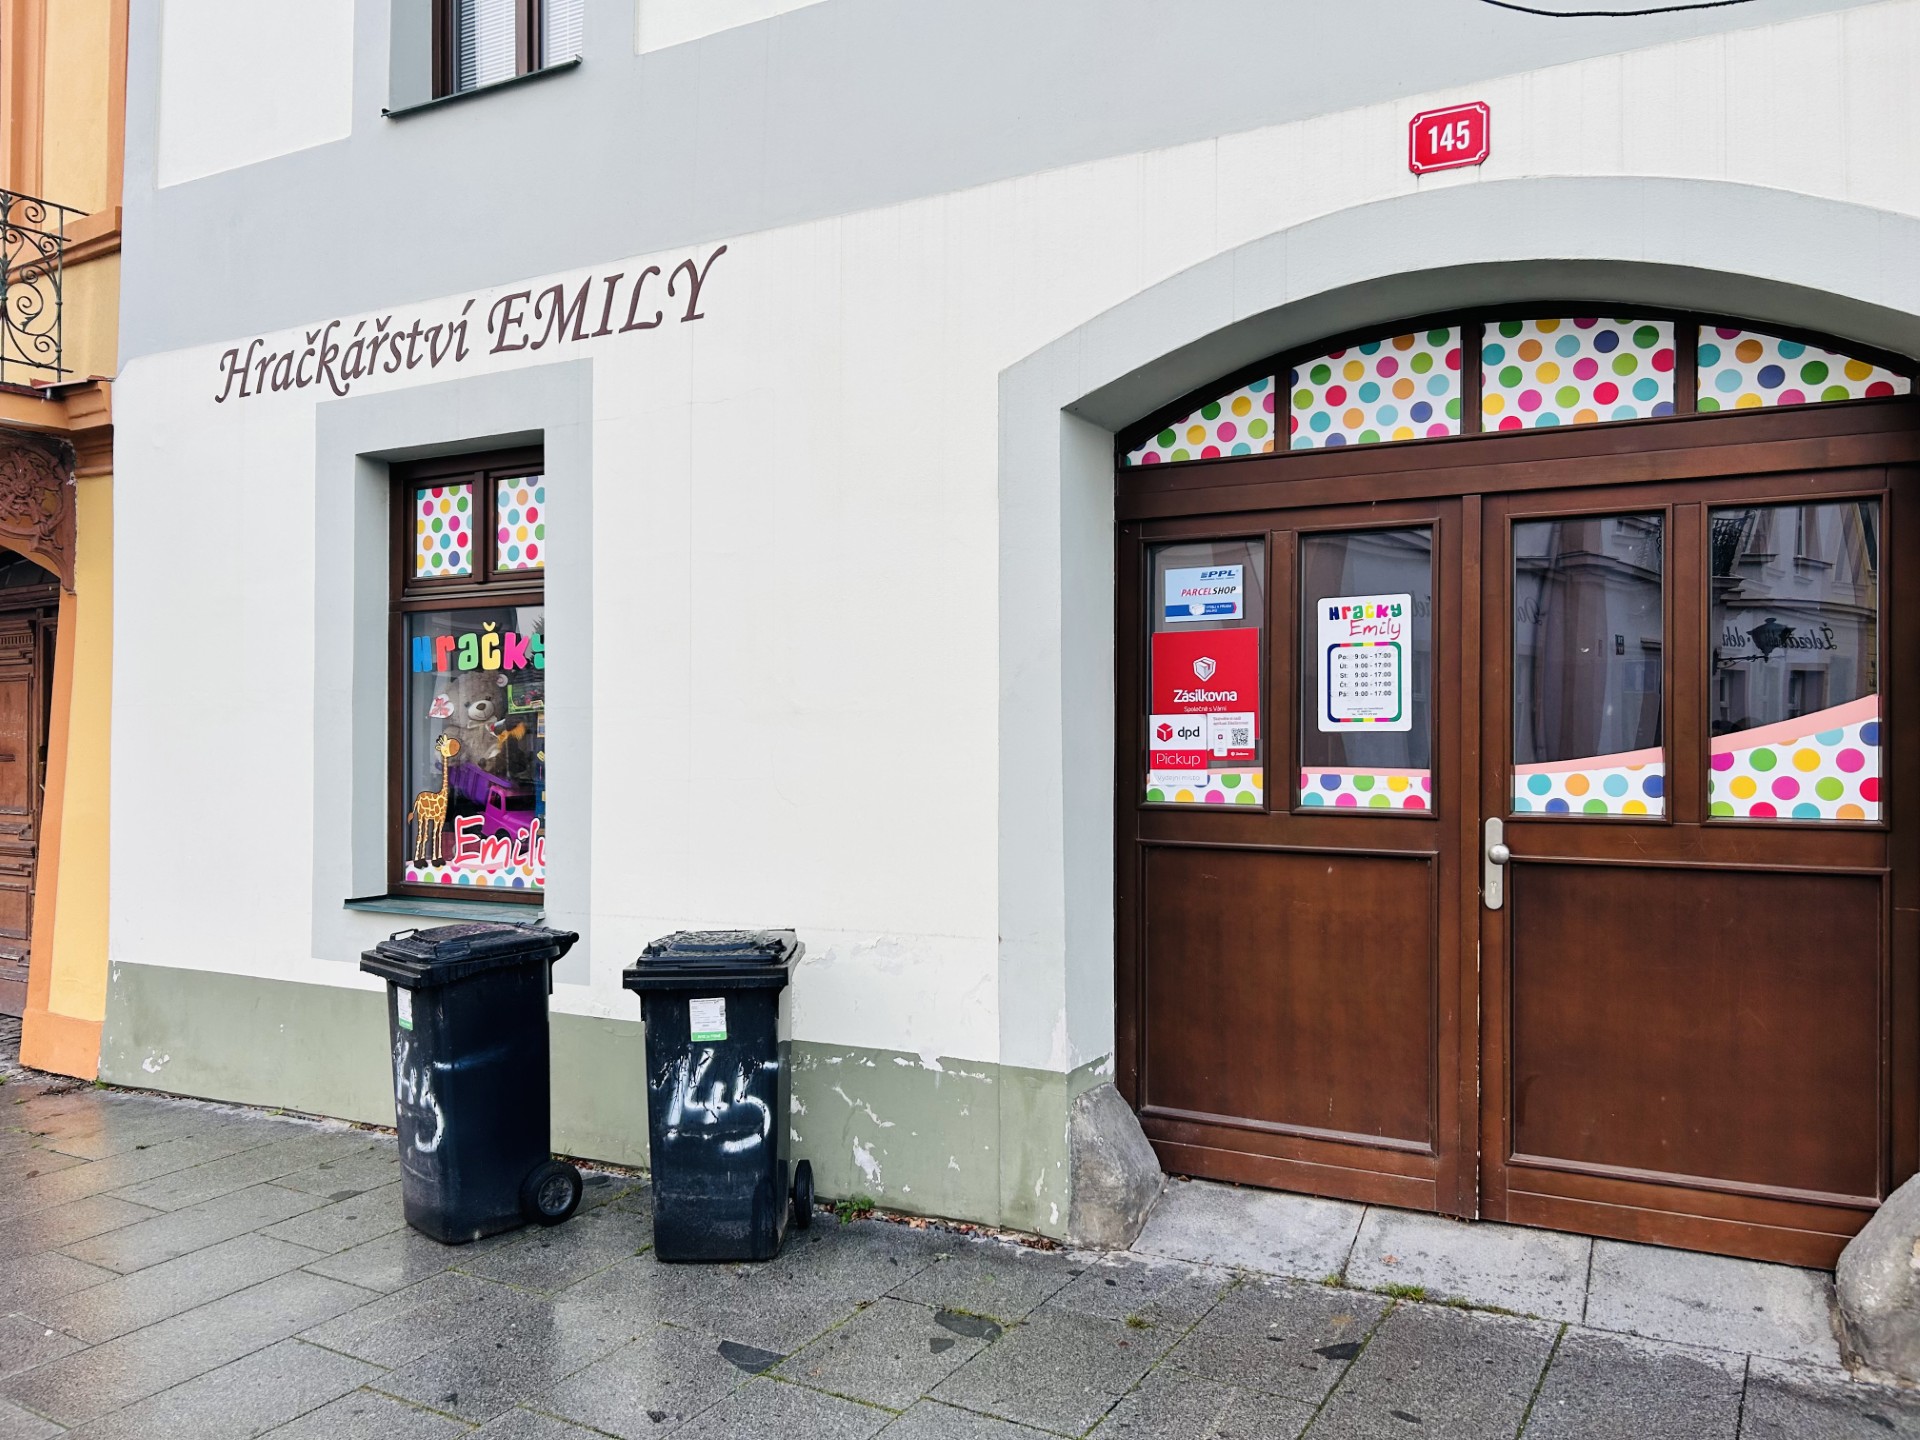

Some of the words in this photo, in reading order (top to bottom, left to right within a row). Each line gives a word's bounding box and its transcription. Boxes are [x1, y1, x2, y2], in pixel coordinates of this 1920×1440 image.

[1428, 120, 1470, 154] 145
[214, 298, 477, 404] Hračkářství
[487, 245, 728, 355] EMILY
[1208, 569, 1237, 579] PPL
[1181, 585, 1237, 598] PARCELSHOP
[1328, 602, 1403, 621] Hračky
[1349, 618, 1401, 641] Emily
[1173, 688, 1238, 703] Zásilkovna
[1177, 726, 1200, 741] dpd
[1156, 753, 1201, 767] Pickup
